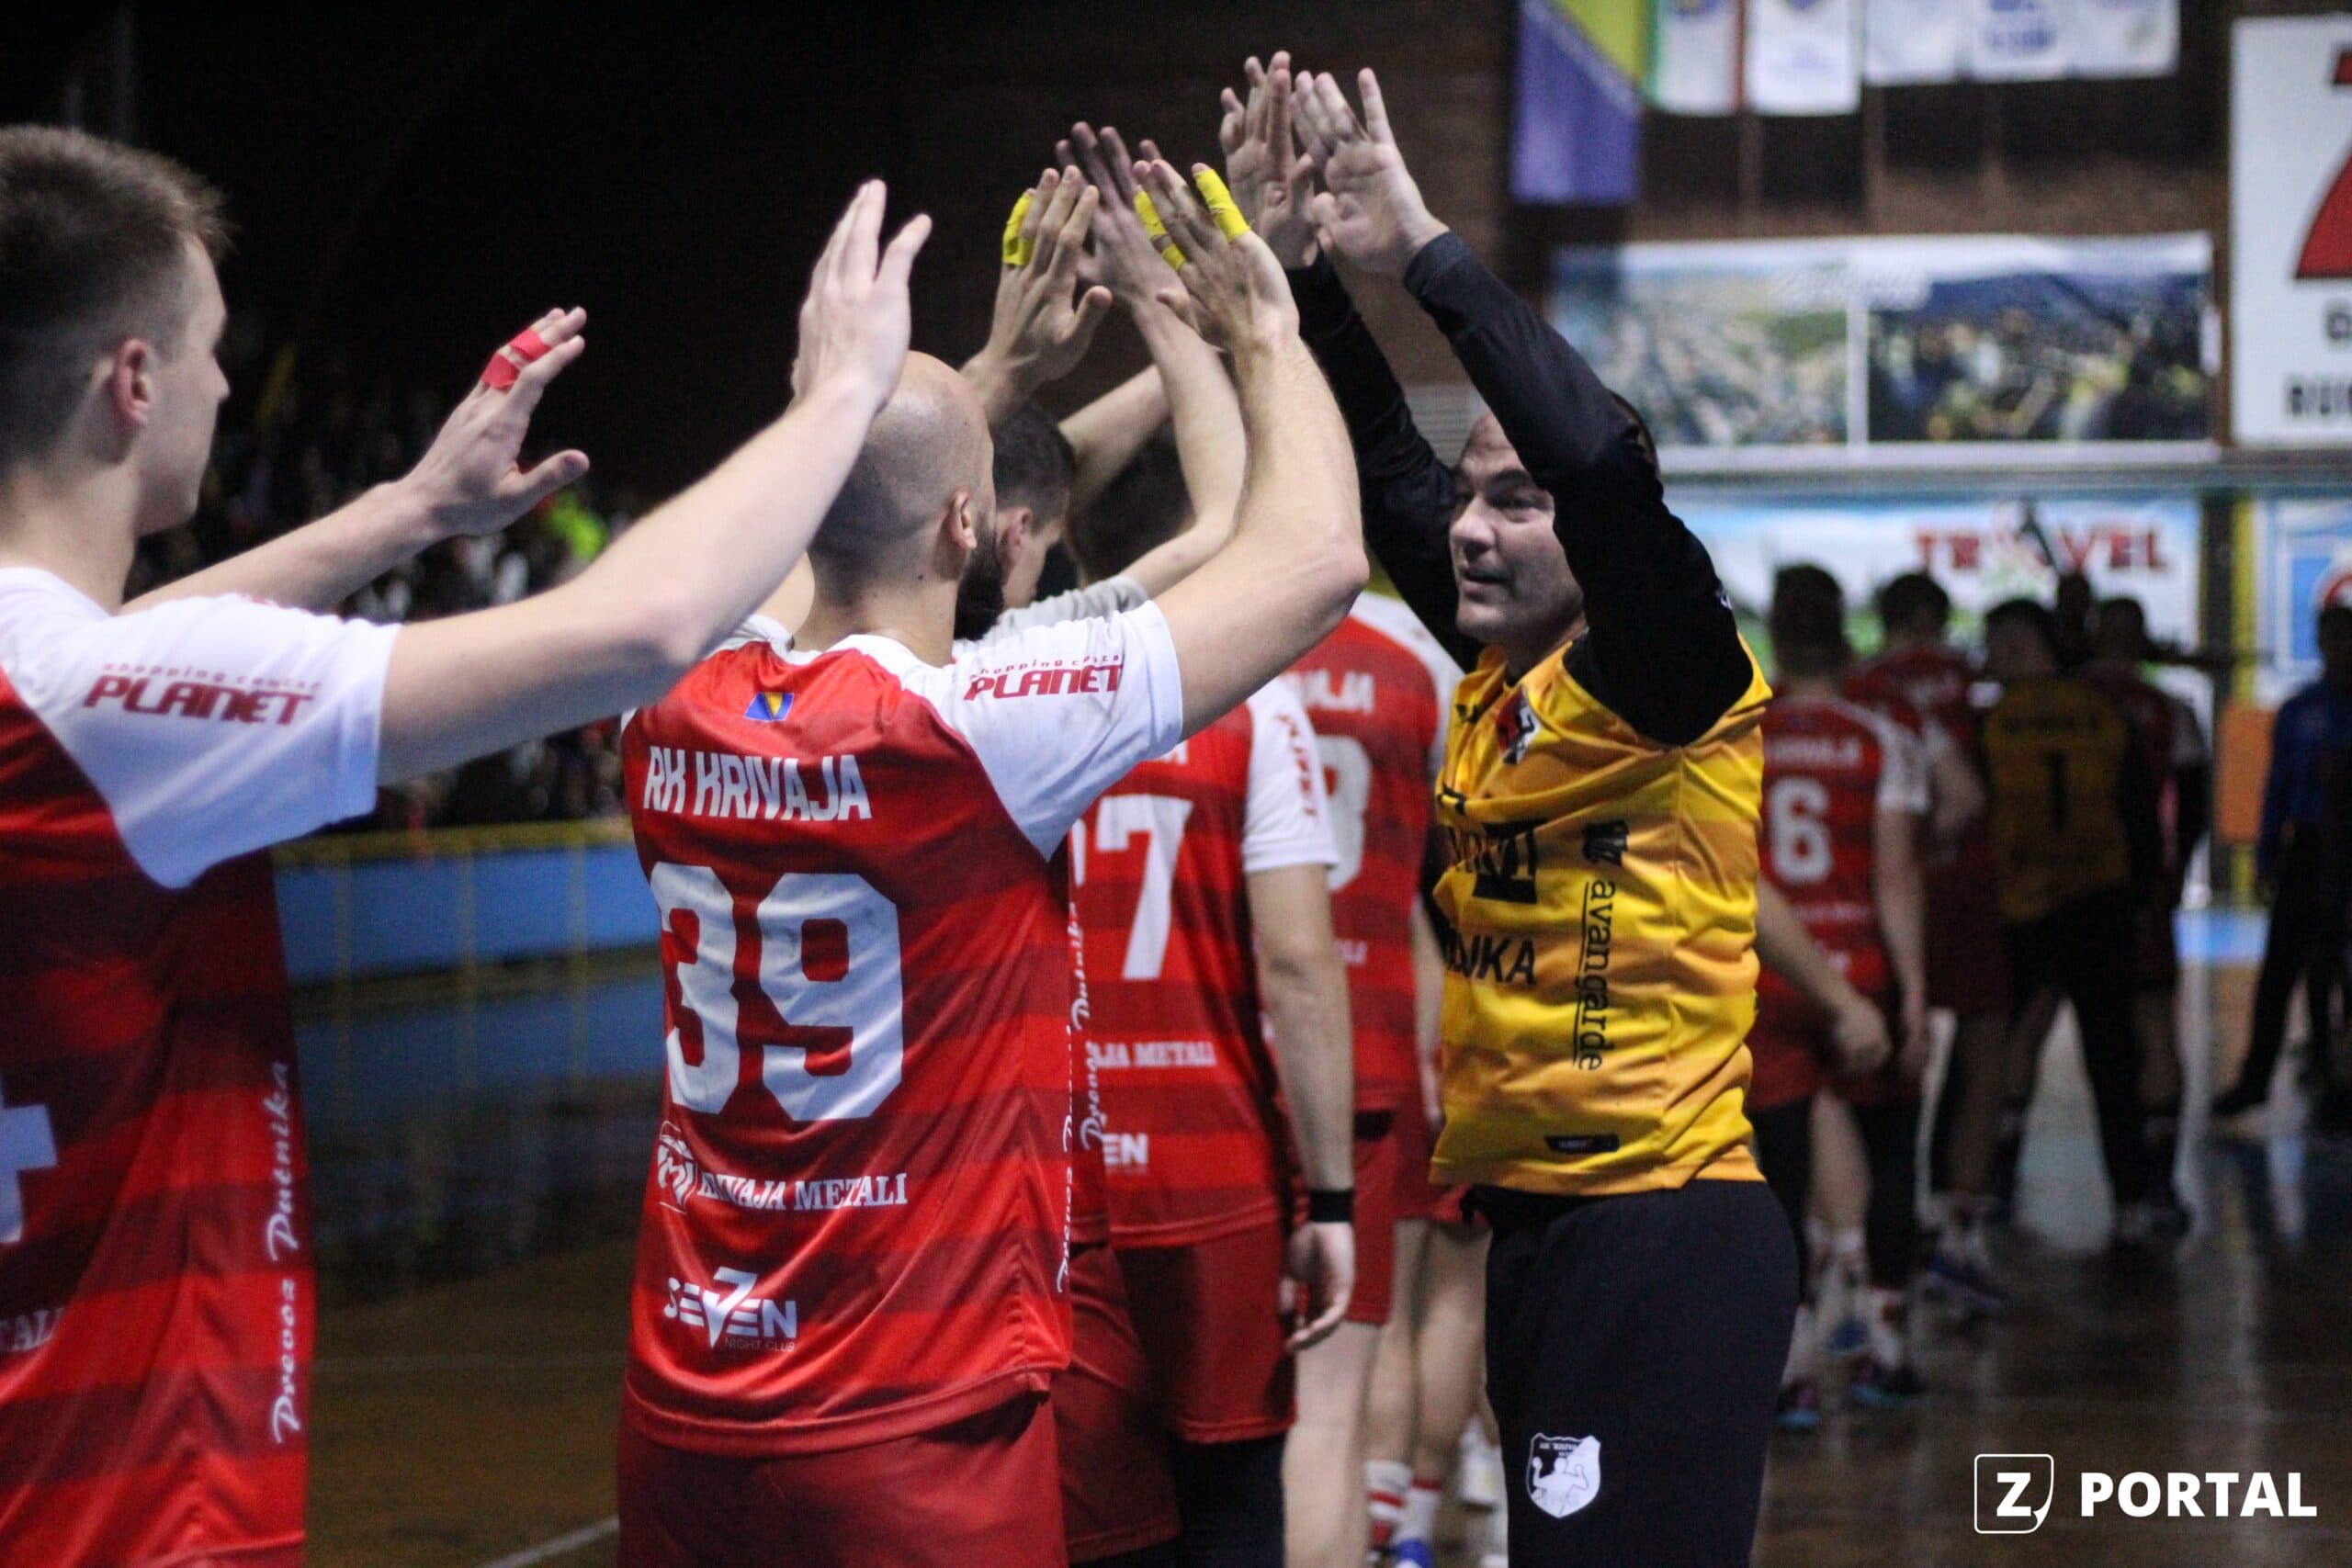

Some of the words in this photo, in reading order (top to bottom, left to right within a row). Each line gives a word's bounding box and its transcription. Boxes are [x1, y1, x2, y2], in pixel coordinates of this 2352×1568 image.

[83, 673, 315, 727] PLANET
[963, 663, 1124, 702] PLANET
[643, 744, 686, 815] RK
[693, 753, 873, 822] KRIVAJA
[1768, 776, 1834, 886] 6
[649, 860, 905, 1122] 39
[1577, 879, 1617, 1071] avangarde
[794, 1172, 908, 1211] METALI
[663, 1266, 798, 1348] SEVEN
